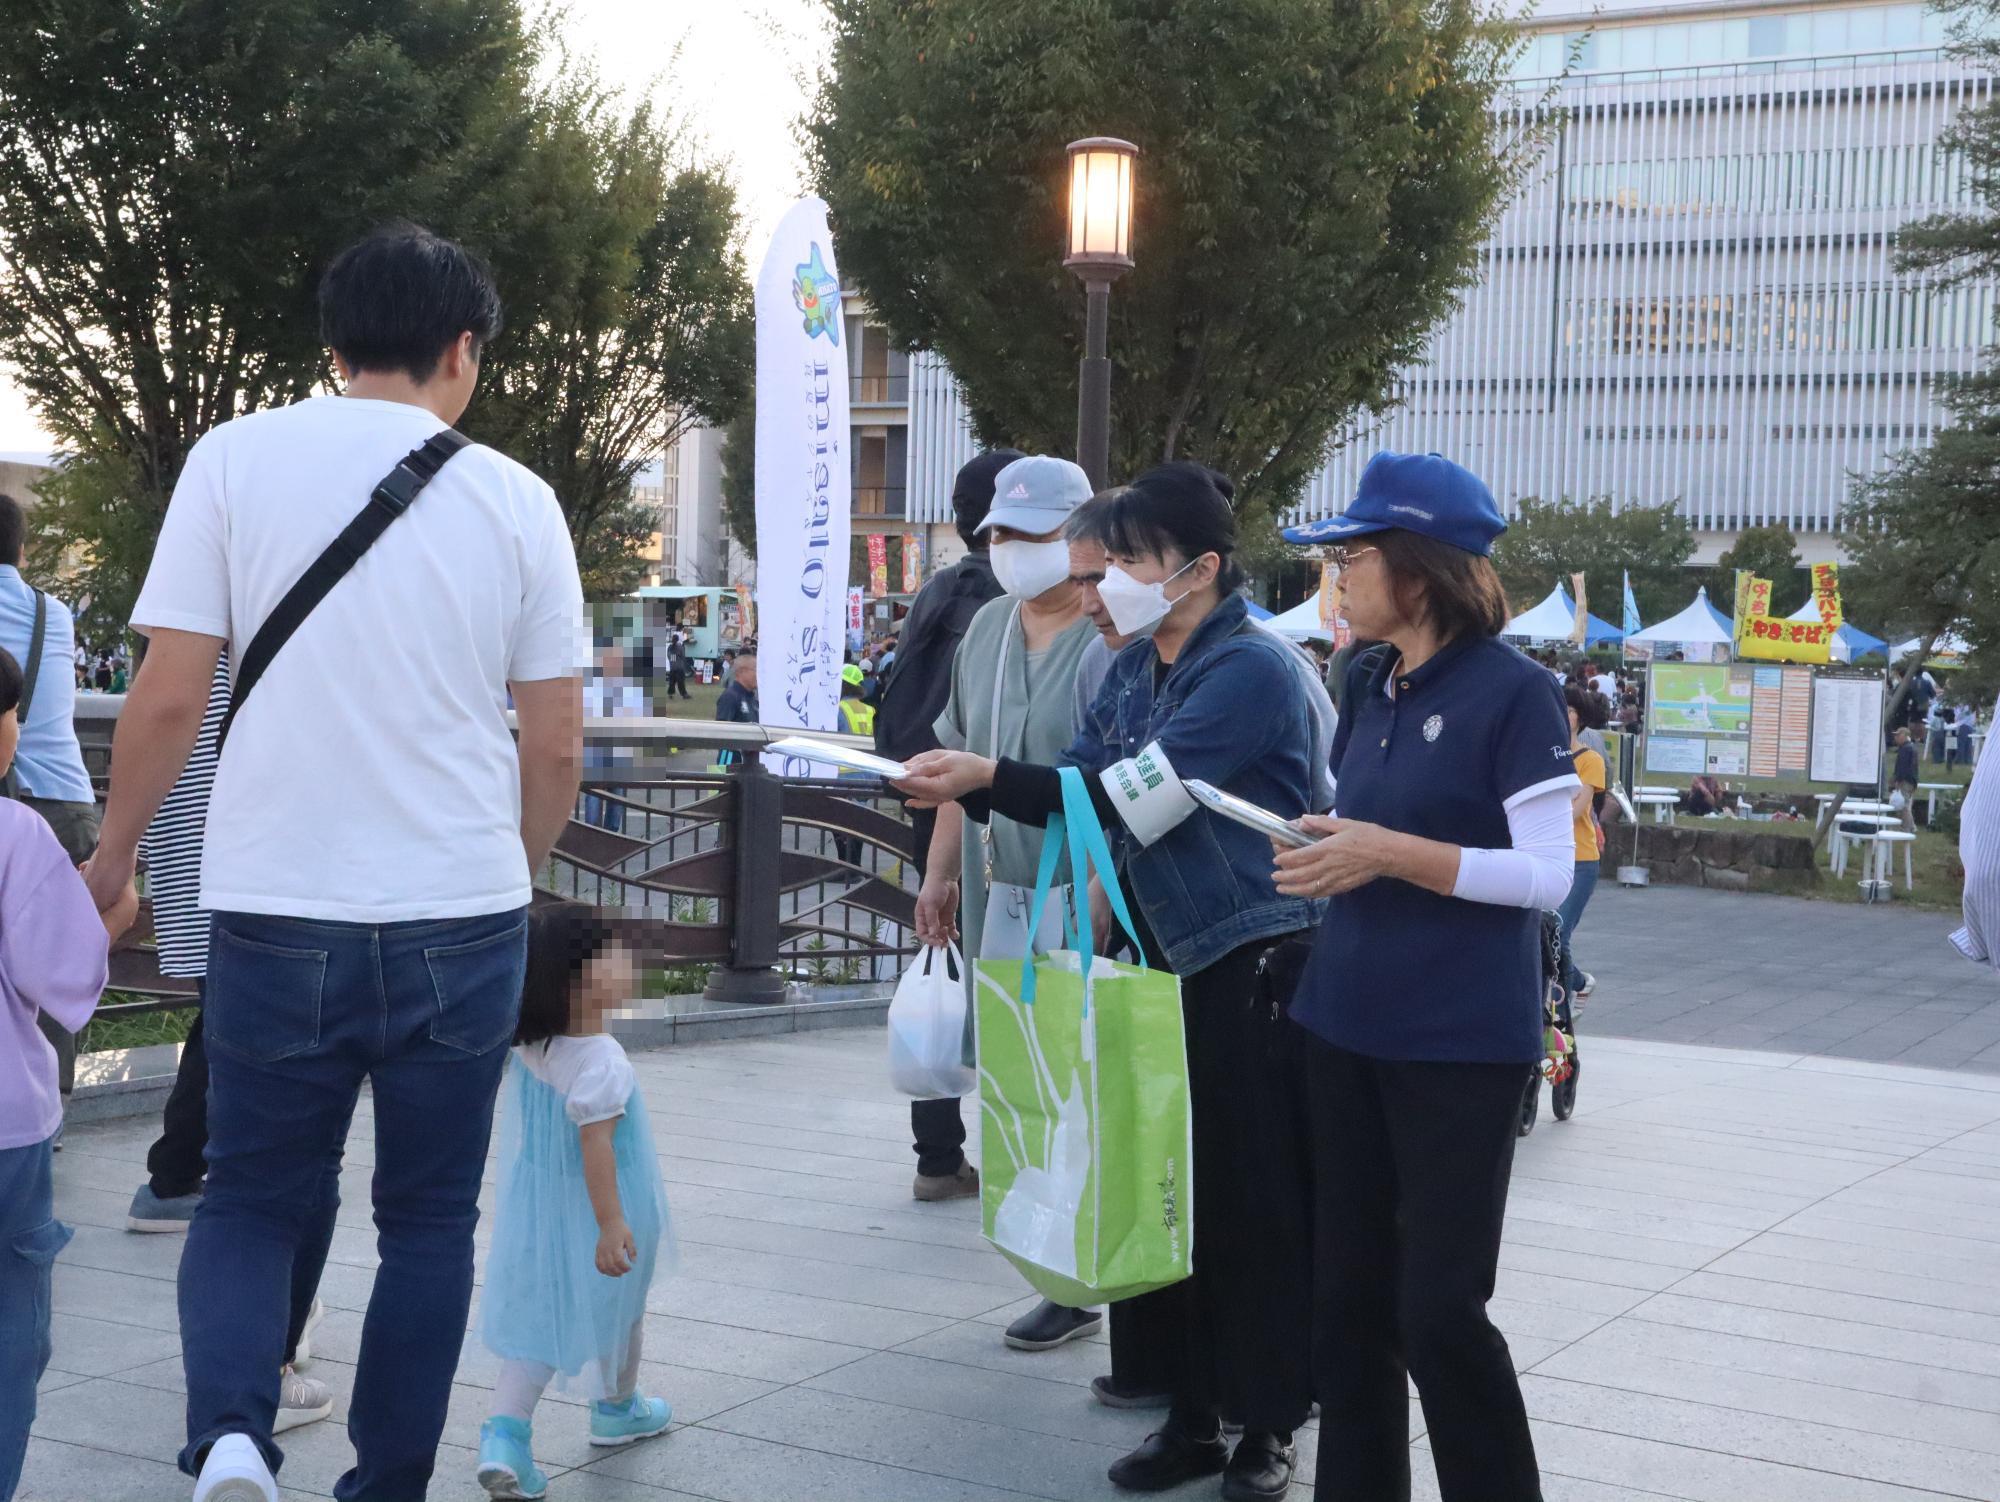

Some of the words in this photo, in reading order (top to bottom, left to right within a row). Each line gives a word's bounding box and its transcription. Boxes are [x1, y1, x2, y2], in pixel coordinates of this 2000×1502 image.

[1753, 619, 1823, 644] やきそば
[783, 624, 826, 778] stye
